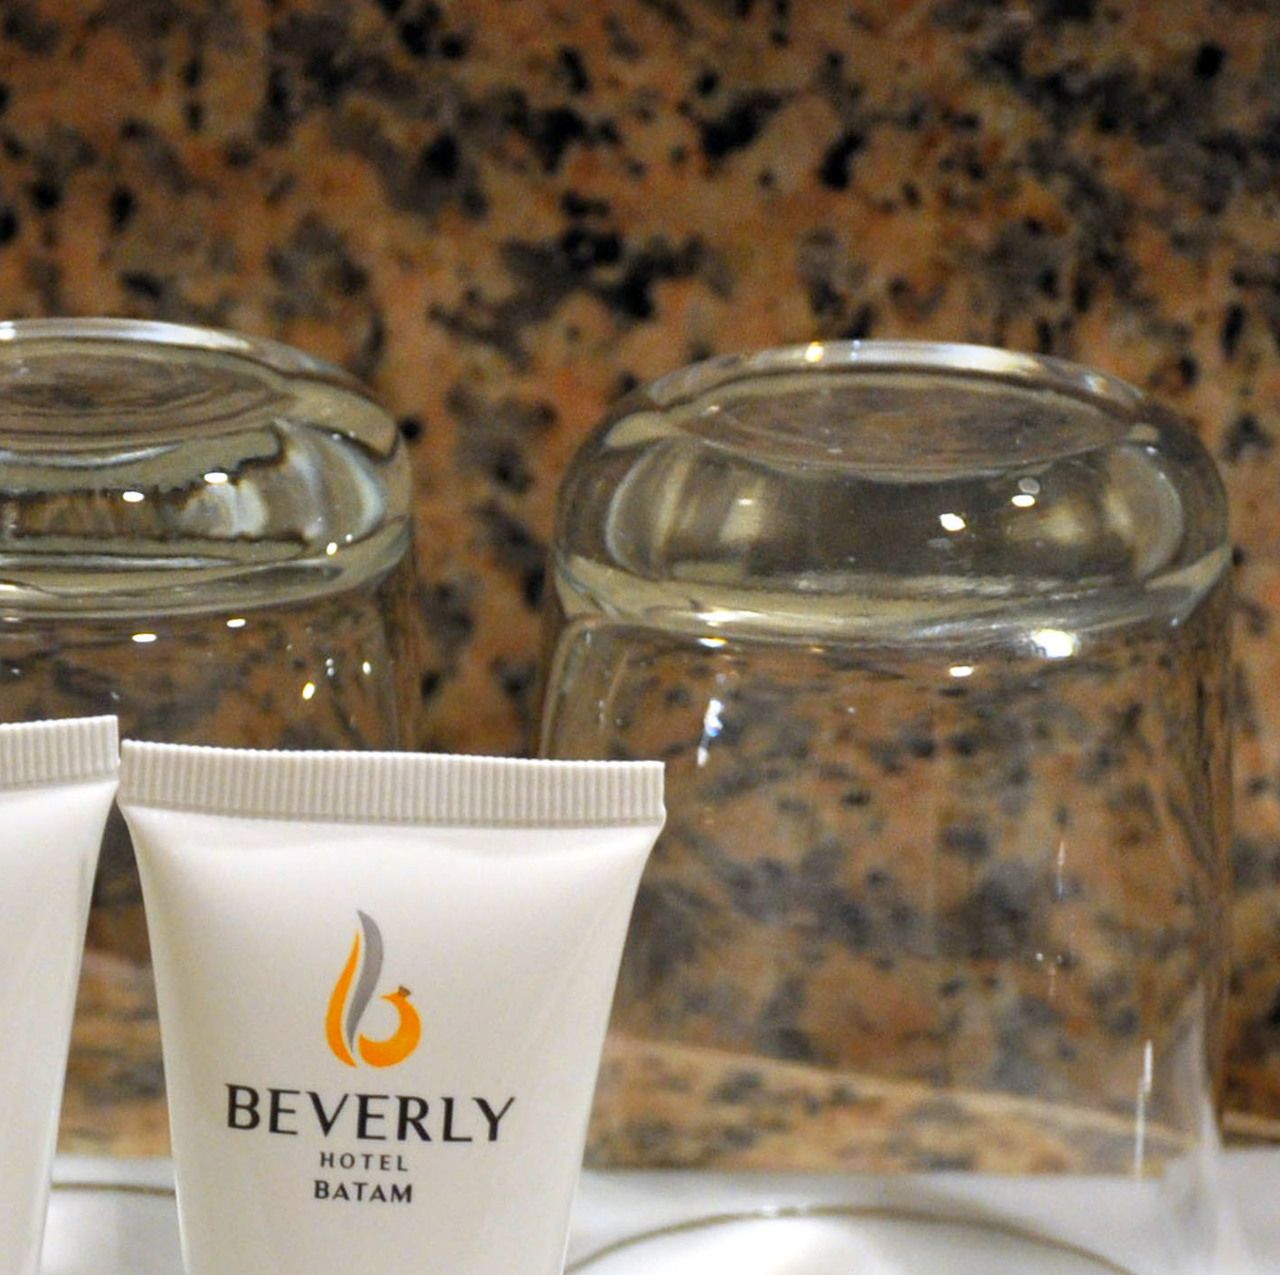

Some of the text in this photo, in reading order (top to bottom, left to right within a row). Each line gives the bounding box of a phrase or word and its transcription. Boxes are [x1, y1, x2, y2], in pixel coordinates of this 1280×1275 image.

[225, 1083, 516, 1143] BEVERLY
[320, 1151, 409, 1172] HOTEL
[314, 1179, 414, 1204] BATAM
